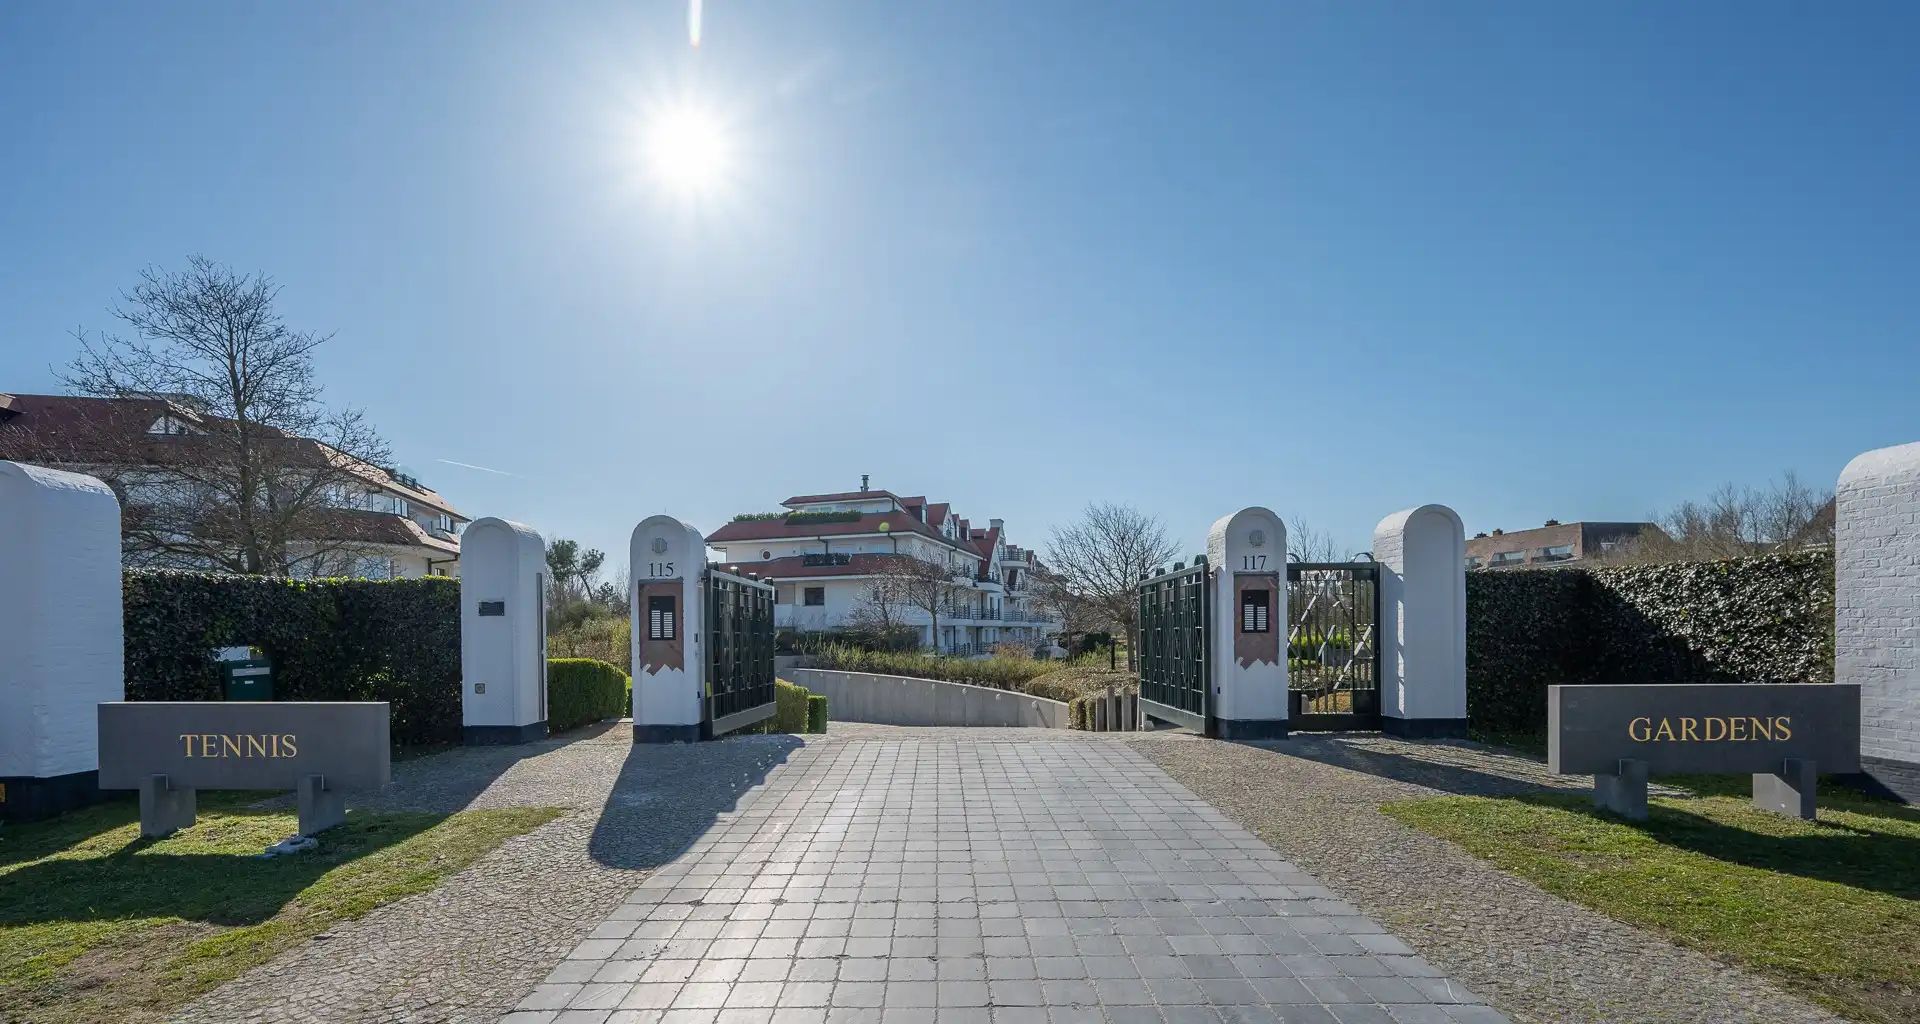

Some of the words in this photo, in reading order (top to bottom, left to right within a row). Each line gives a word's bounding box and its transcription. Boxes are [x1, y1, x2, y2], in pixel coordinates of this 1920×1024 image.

[649, 562, 674, 577] 115
[1243, 555, 1267, 570] 117
[1629, 716, 1792, 743] GARDENS
[180, 733, 298, 758] TENNIS
